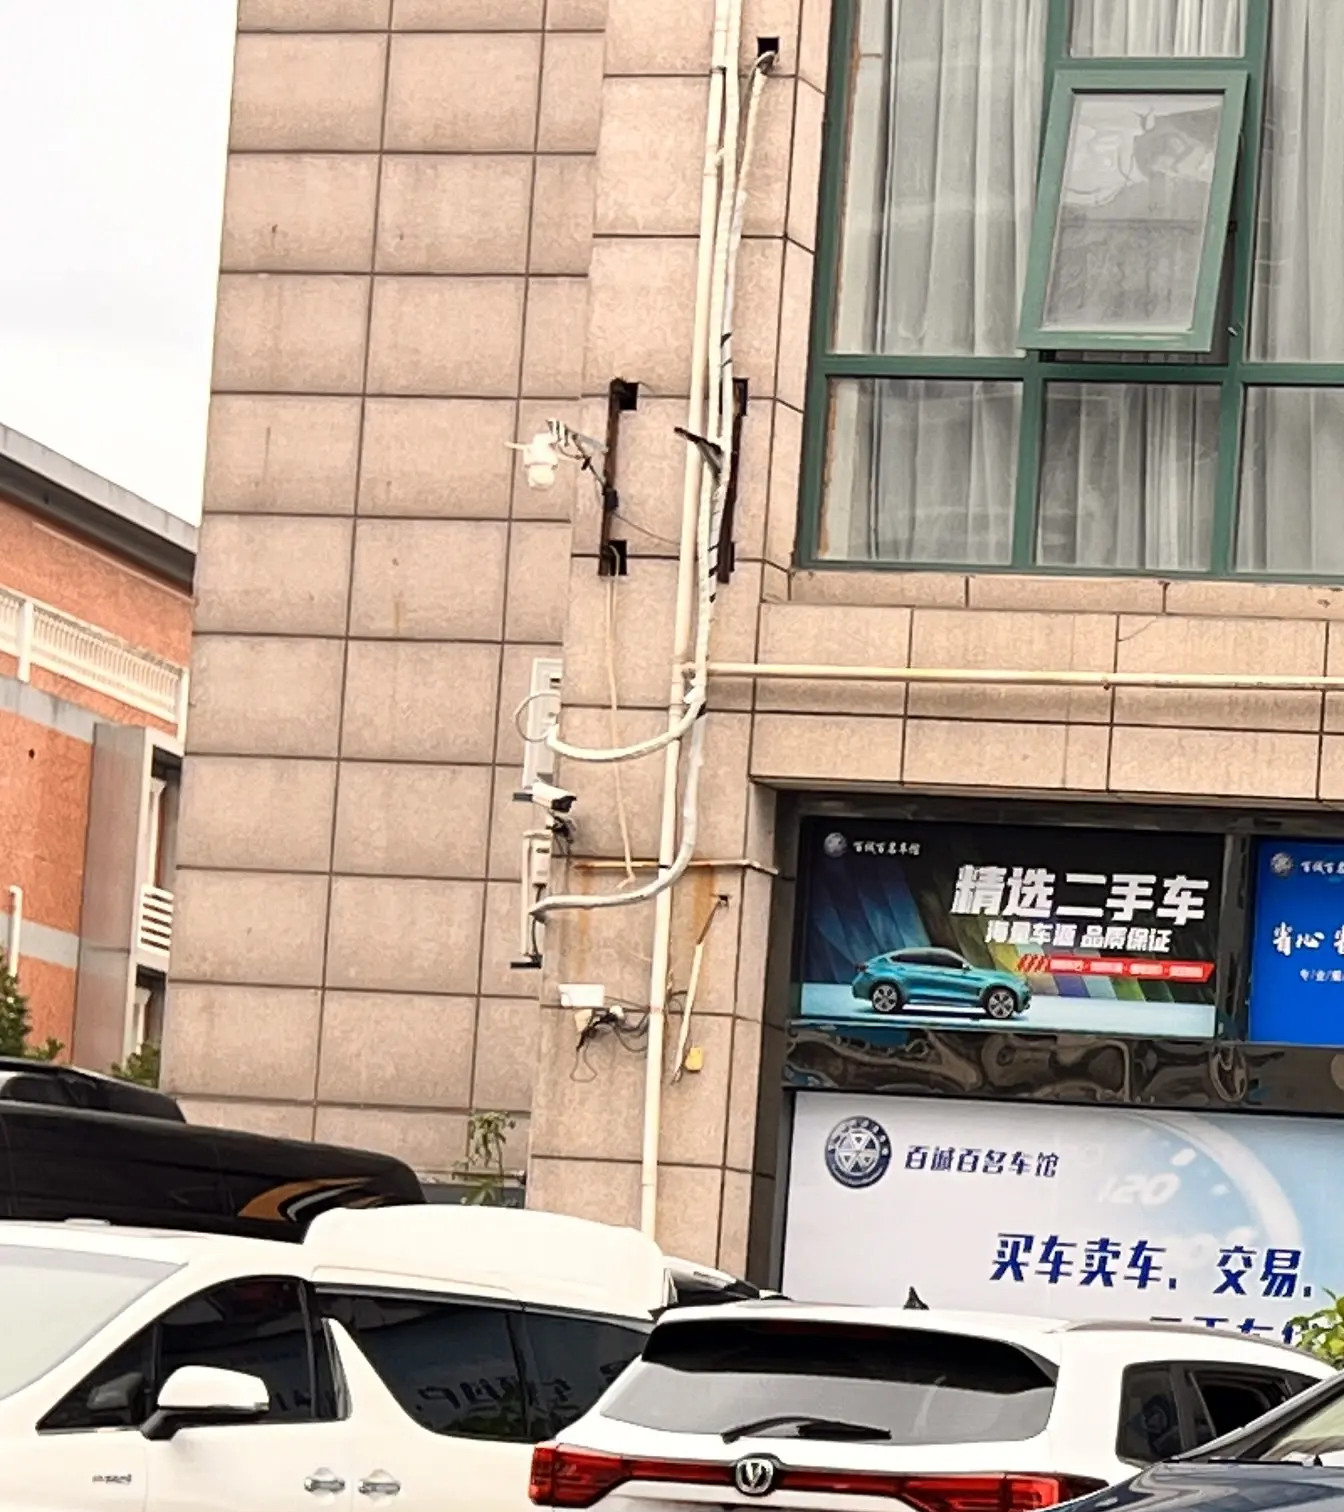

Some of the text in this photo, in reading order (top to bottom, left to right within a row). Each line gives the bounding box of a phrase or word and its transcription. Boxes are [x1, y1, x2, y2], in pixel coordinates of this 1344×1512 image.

[950, 863, 1210, 926] 精选二手车
[1080, 924, 1173, 953] 品质保证
[1272, 921, 1326, 957] 省心
[904, 1144, 1060, 1179] 百诚百名车馆
